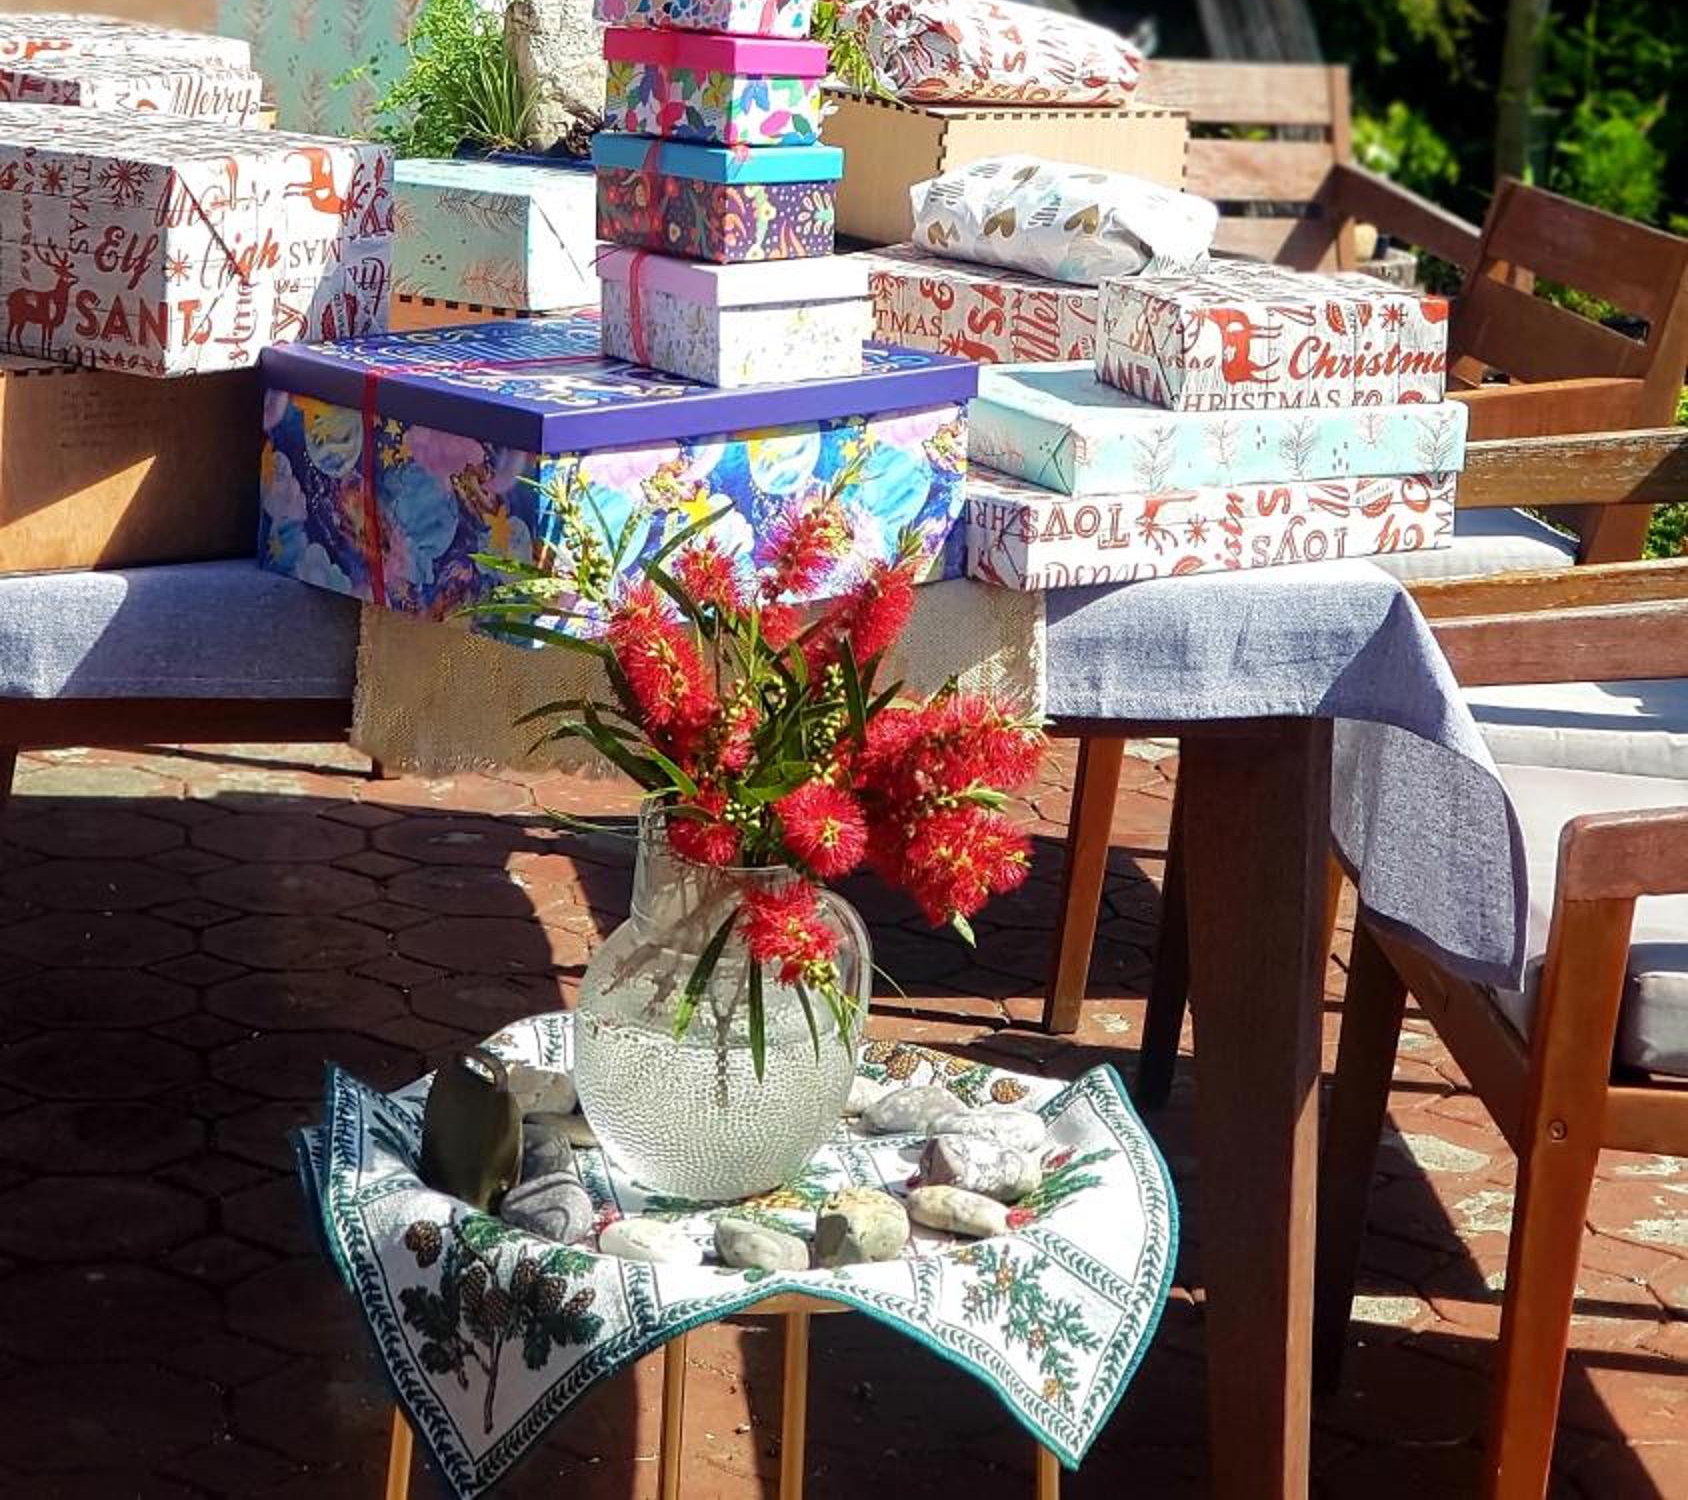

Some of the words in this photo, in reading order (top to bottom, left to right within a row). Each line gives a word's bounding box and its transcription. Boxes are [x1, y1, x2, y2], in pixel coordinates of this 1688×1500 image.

[170, 73, 258, 125] Merry
[95, 226, 158, 290] Elf
[875, 309, 943, 338] TMAS
